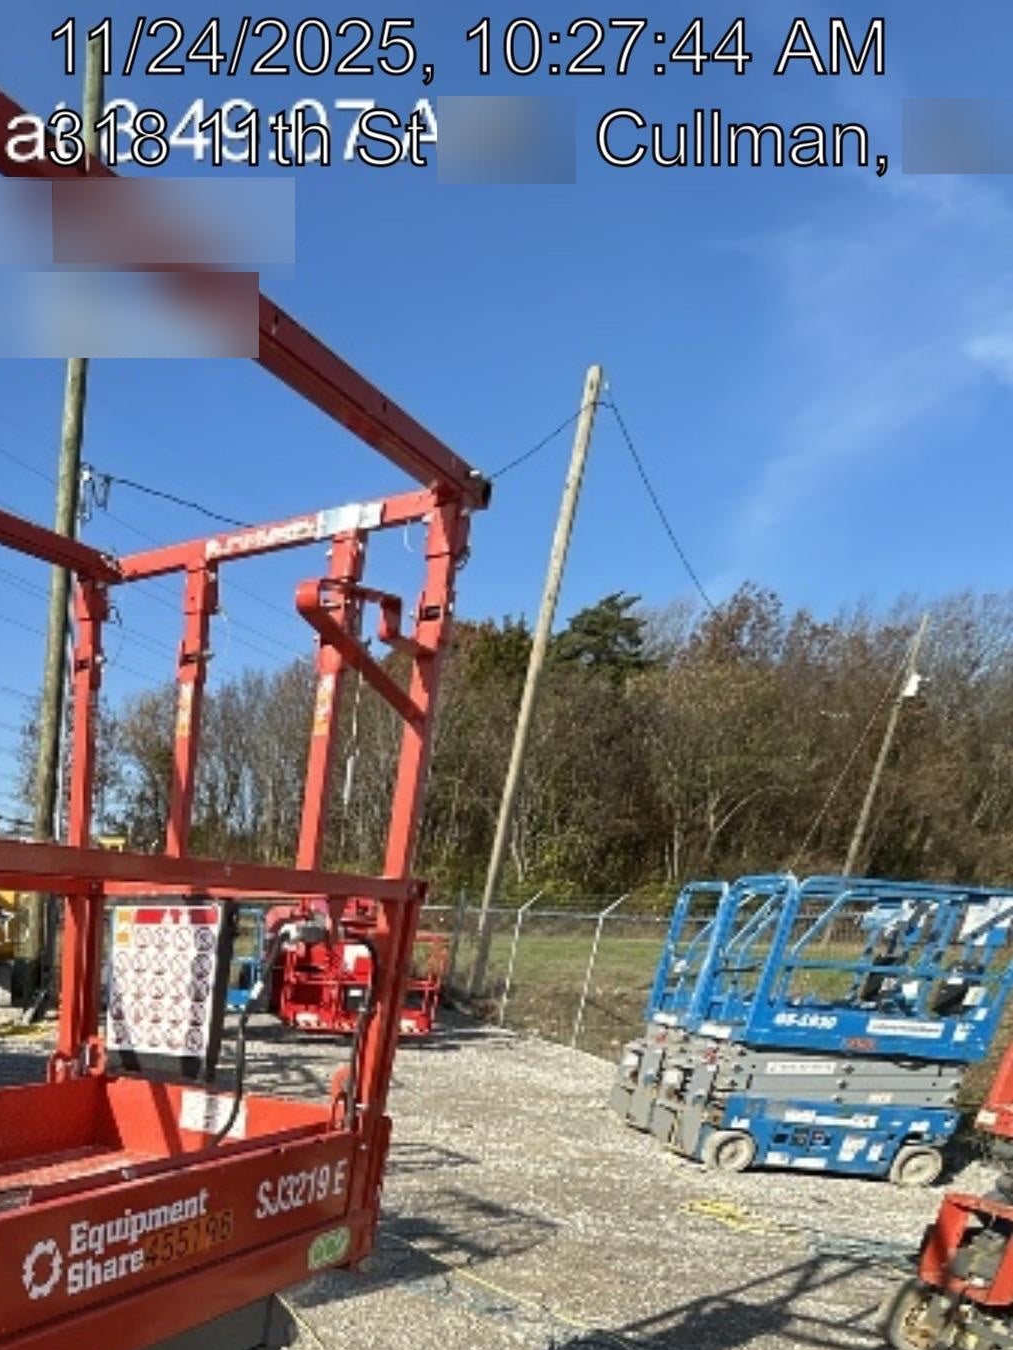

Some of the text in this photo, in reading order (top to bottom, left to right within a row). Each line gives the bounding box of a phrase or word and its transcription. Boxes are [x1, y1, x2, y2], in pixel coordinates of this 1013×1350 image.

[255, 1157, 349, 1219] SJ3219 E
[68, 1188, 210, 1257] Equipment
[67, 1245, 144, 1296] Share
